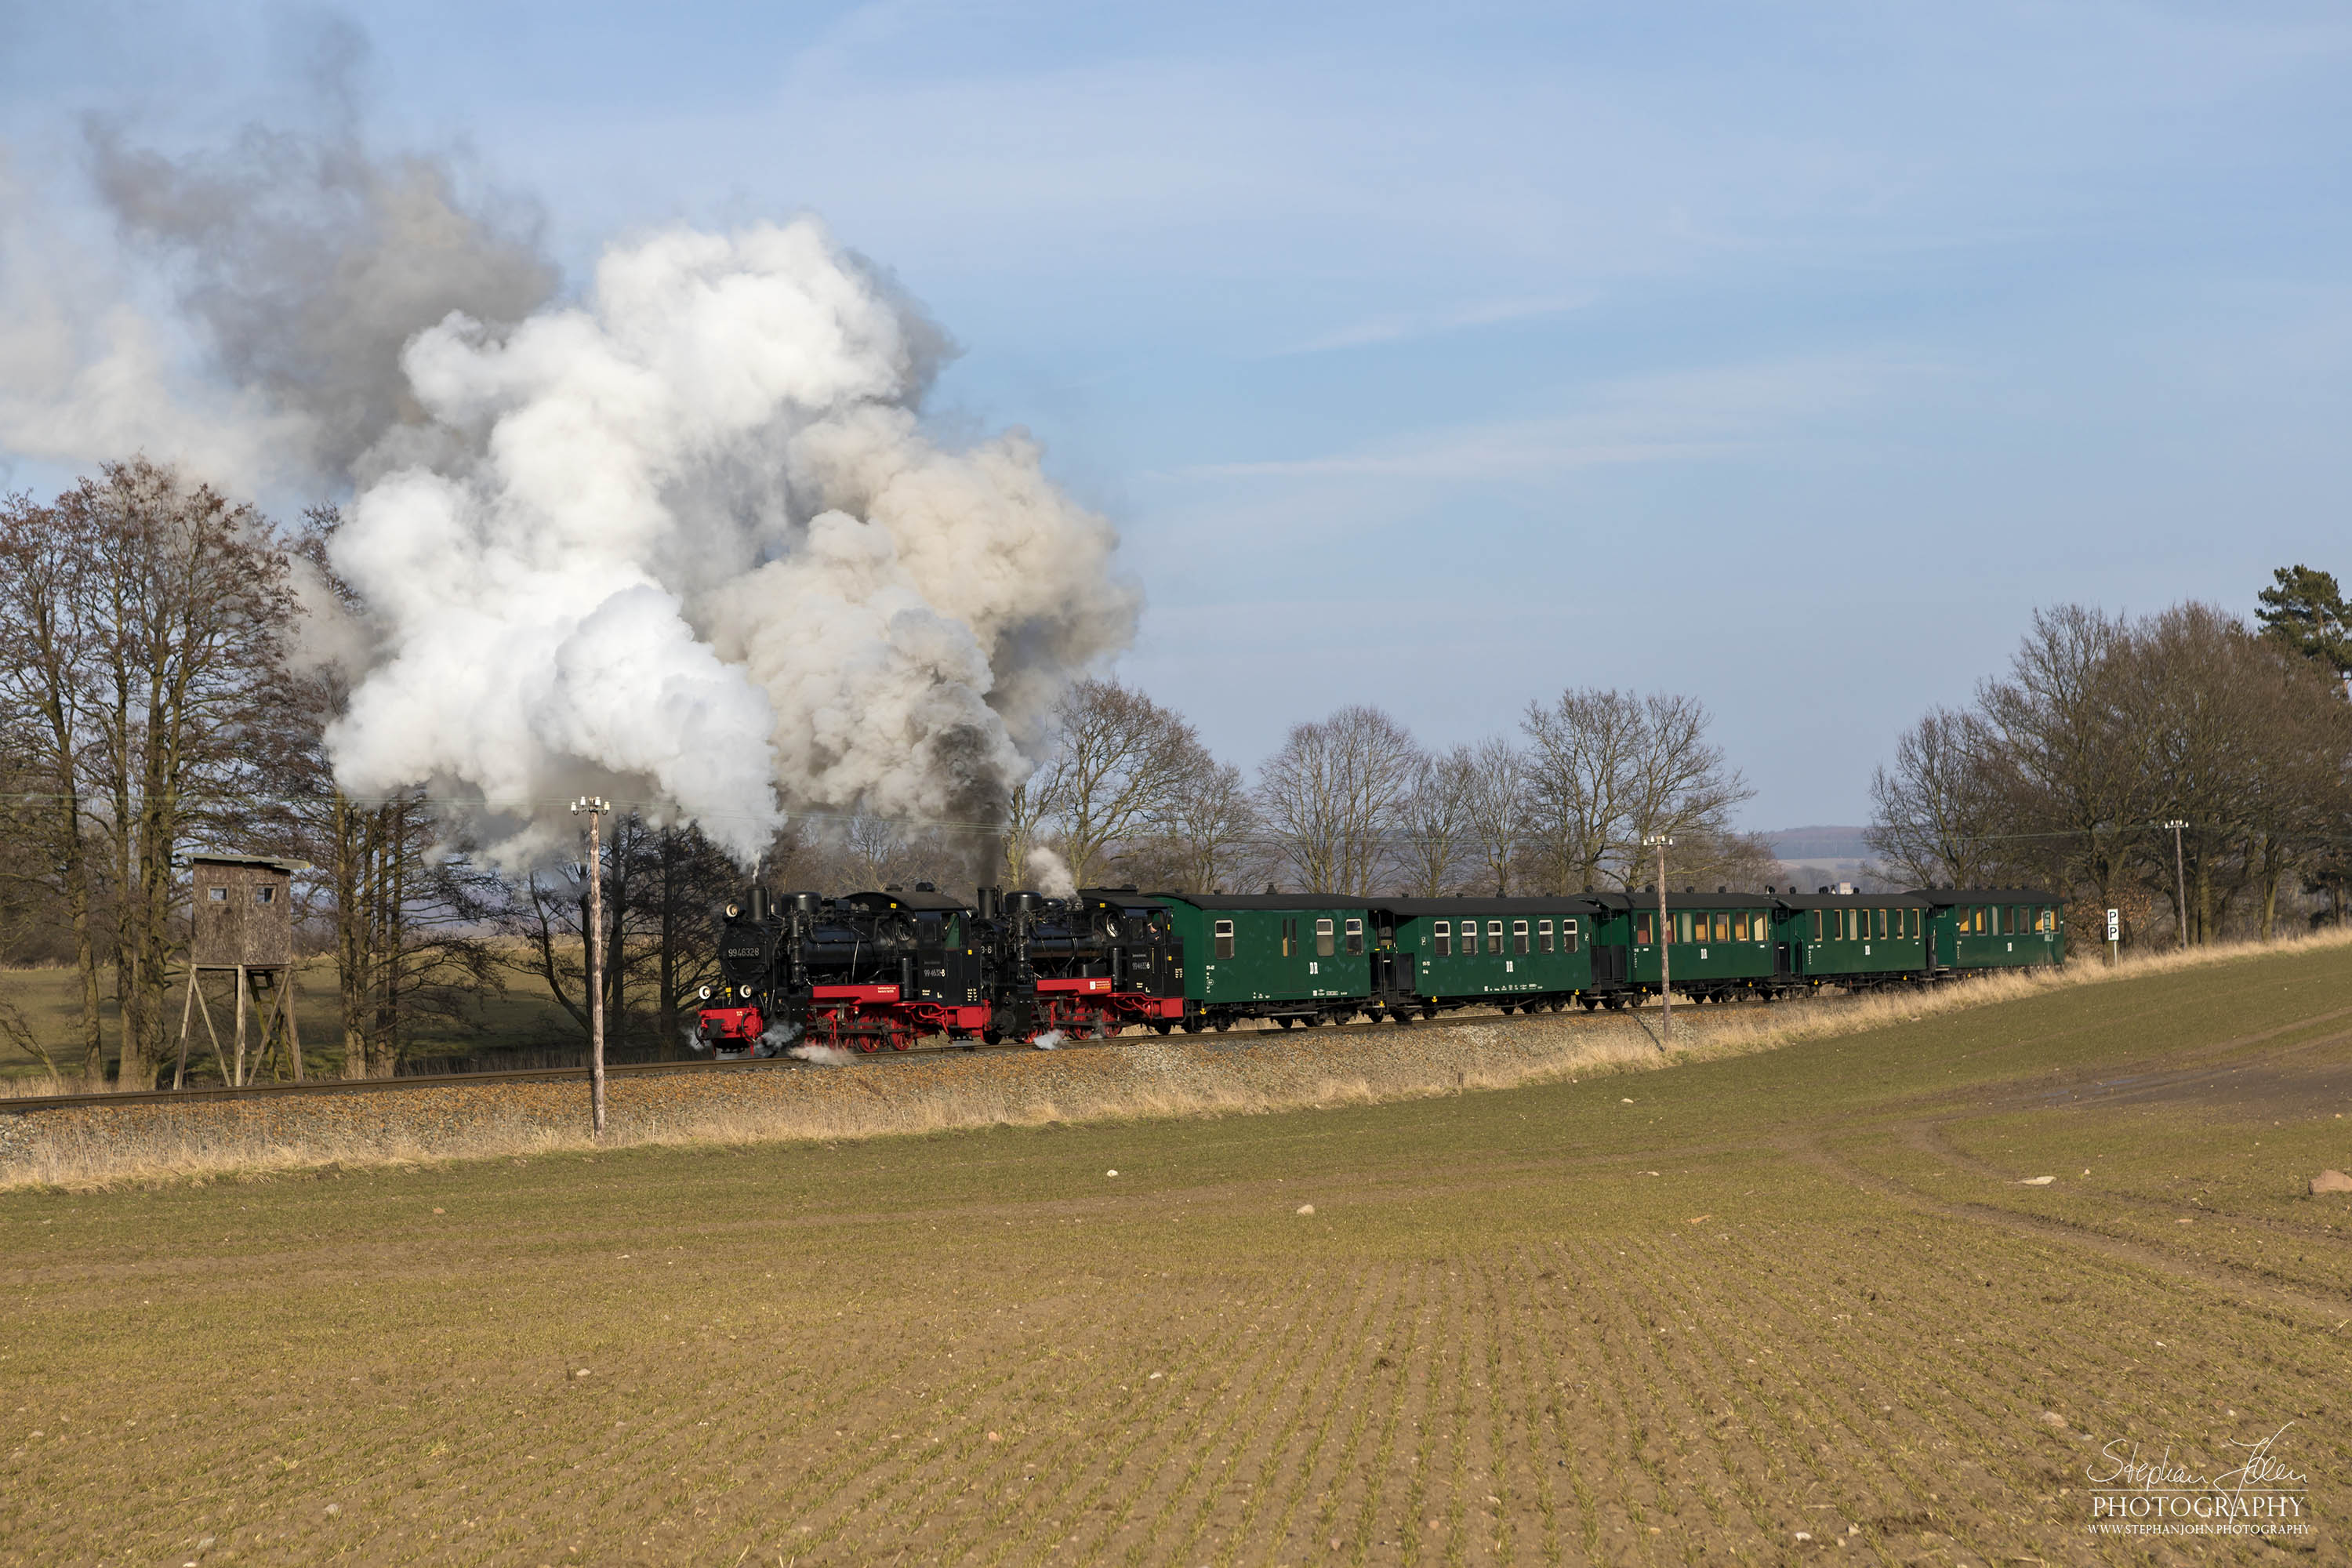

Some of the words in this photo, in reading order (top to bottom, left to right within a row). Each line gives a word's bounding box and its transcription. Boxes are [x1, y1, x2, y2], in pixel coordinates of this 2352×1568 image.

[2110, 911, 2117, 922] P
[2110, 927, 2117, 938] P
[1309, 961, 1318, 975] DR
